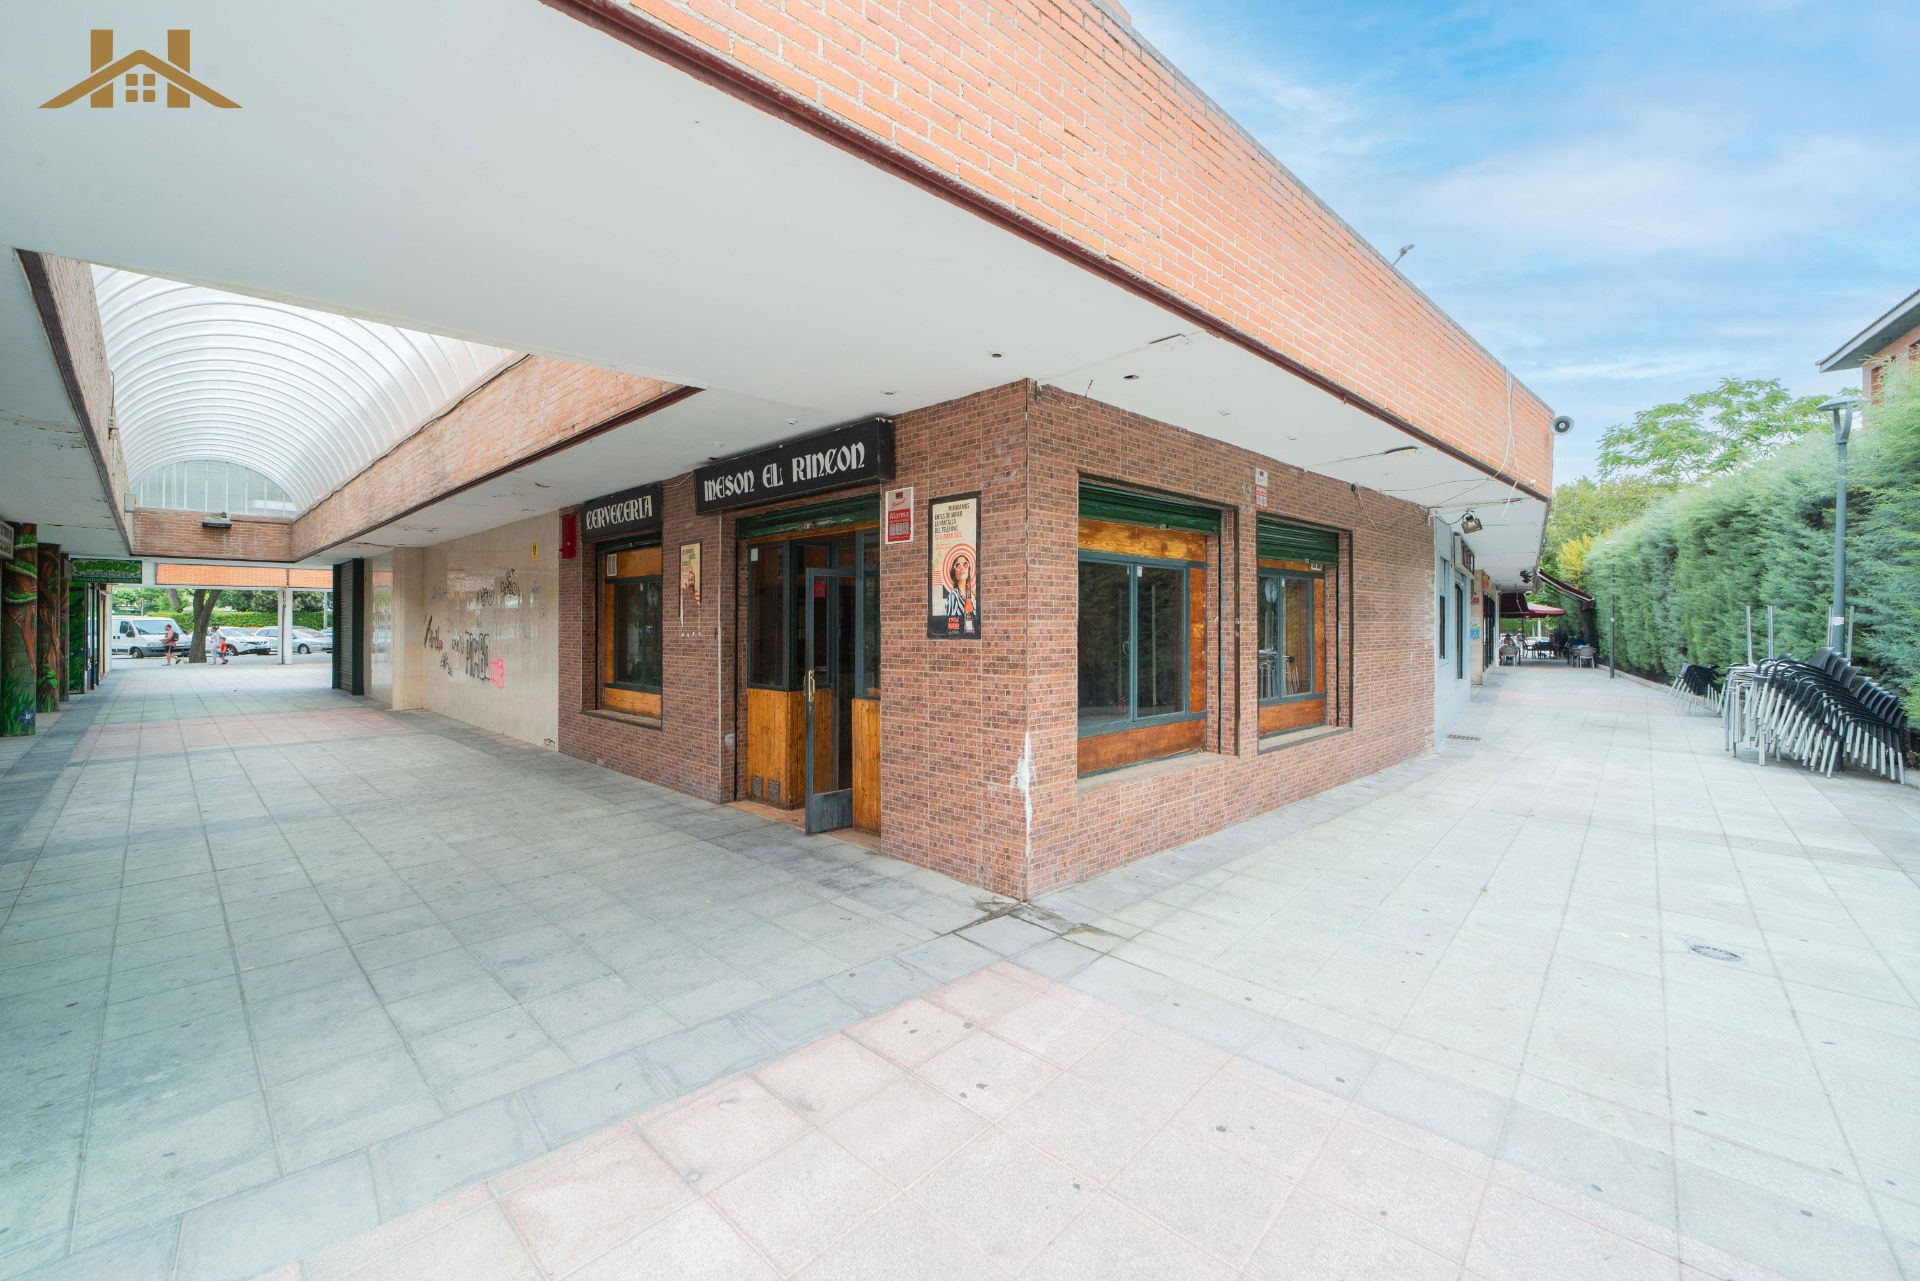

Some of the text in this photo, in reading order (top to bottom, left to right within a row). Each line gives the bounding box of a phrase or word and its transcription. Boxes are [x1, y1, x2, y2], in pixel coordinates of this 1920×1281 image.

[704, 441, 865, 502] MESON EL RINCON
[586, 495, 653, 531] CERVECERIA
